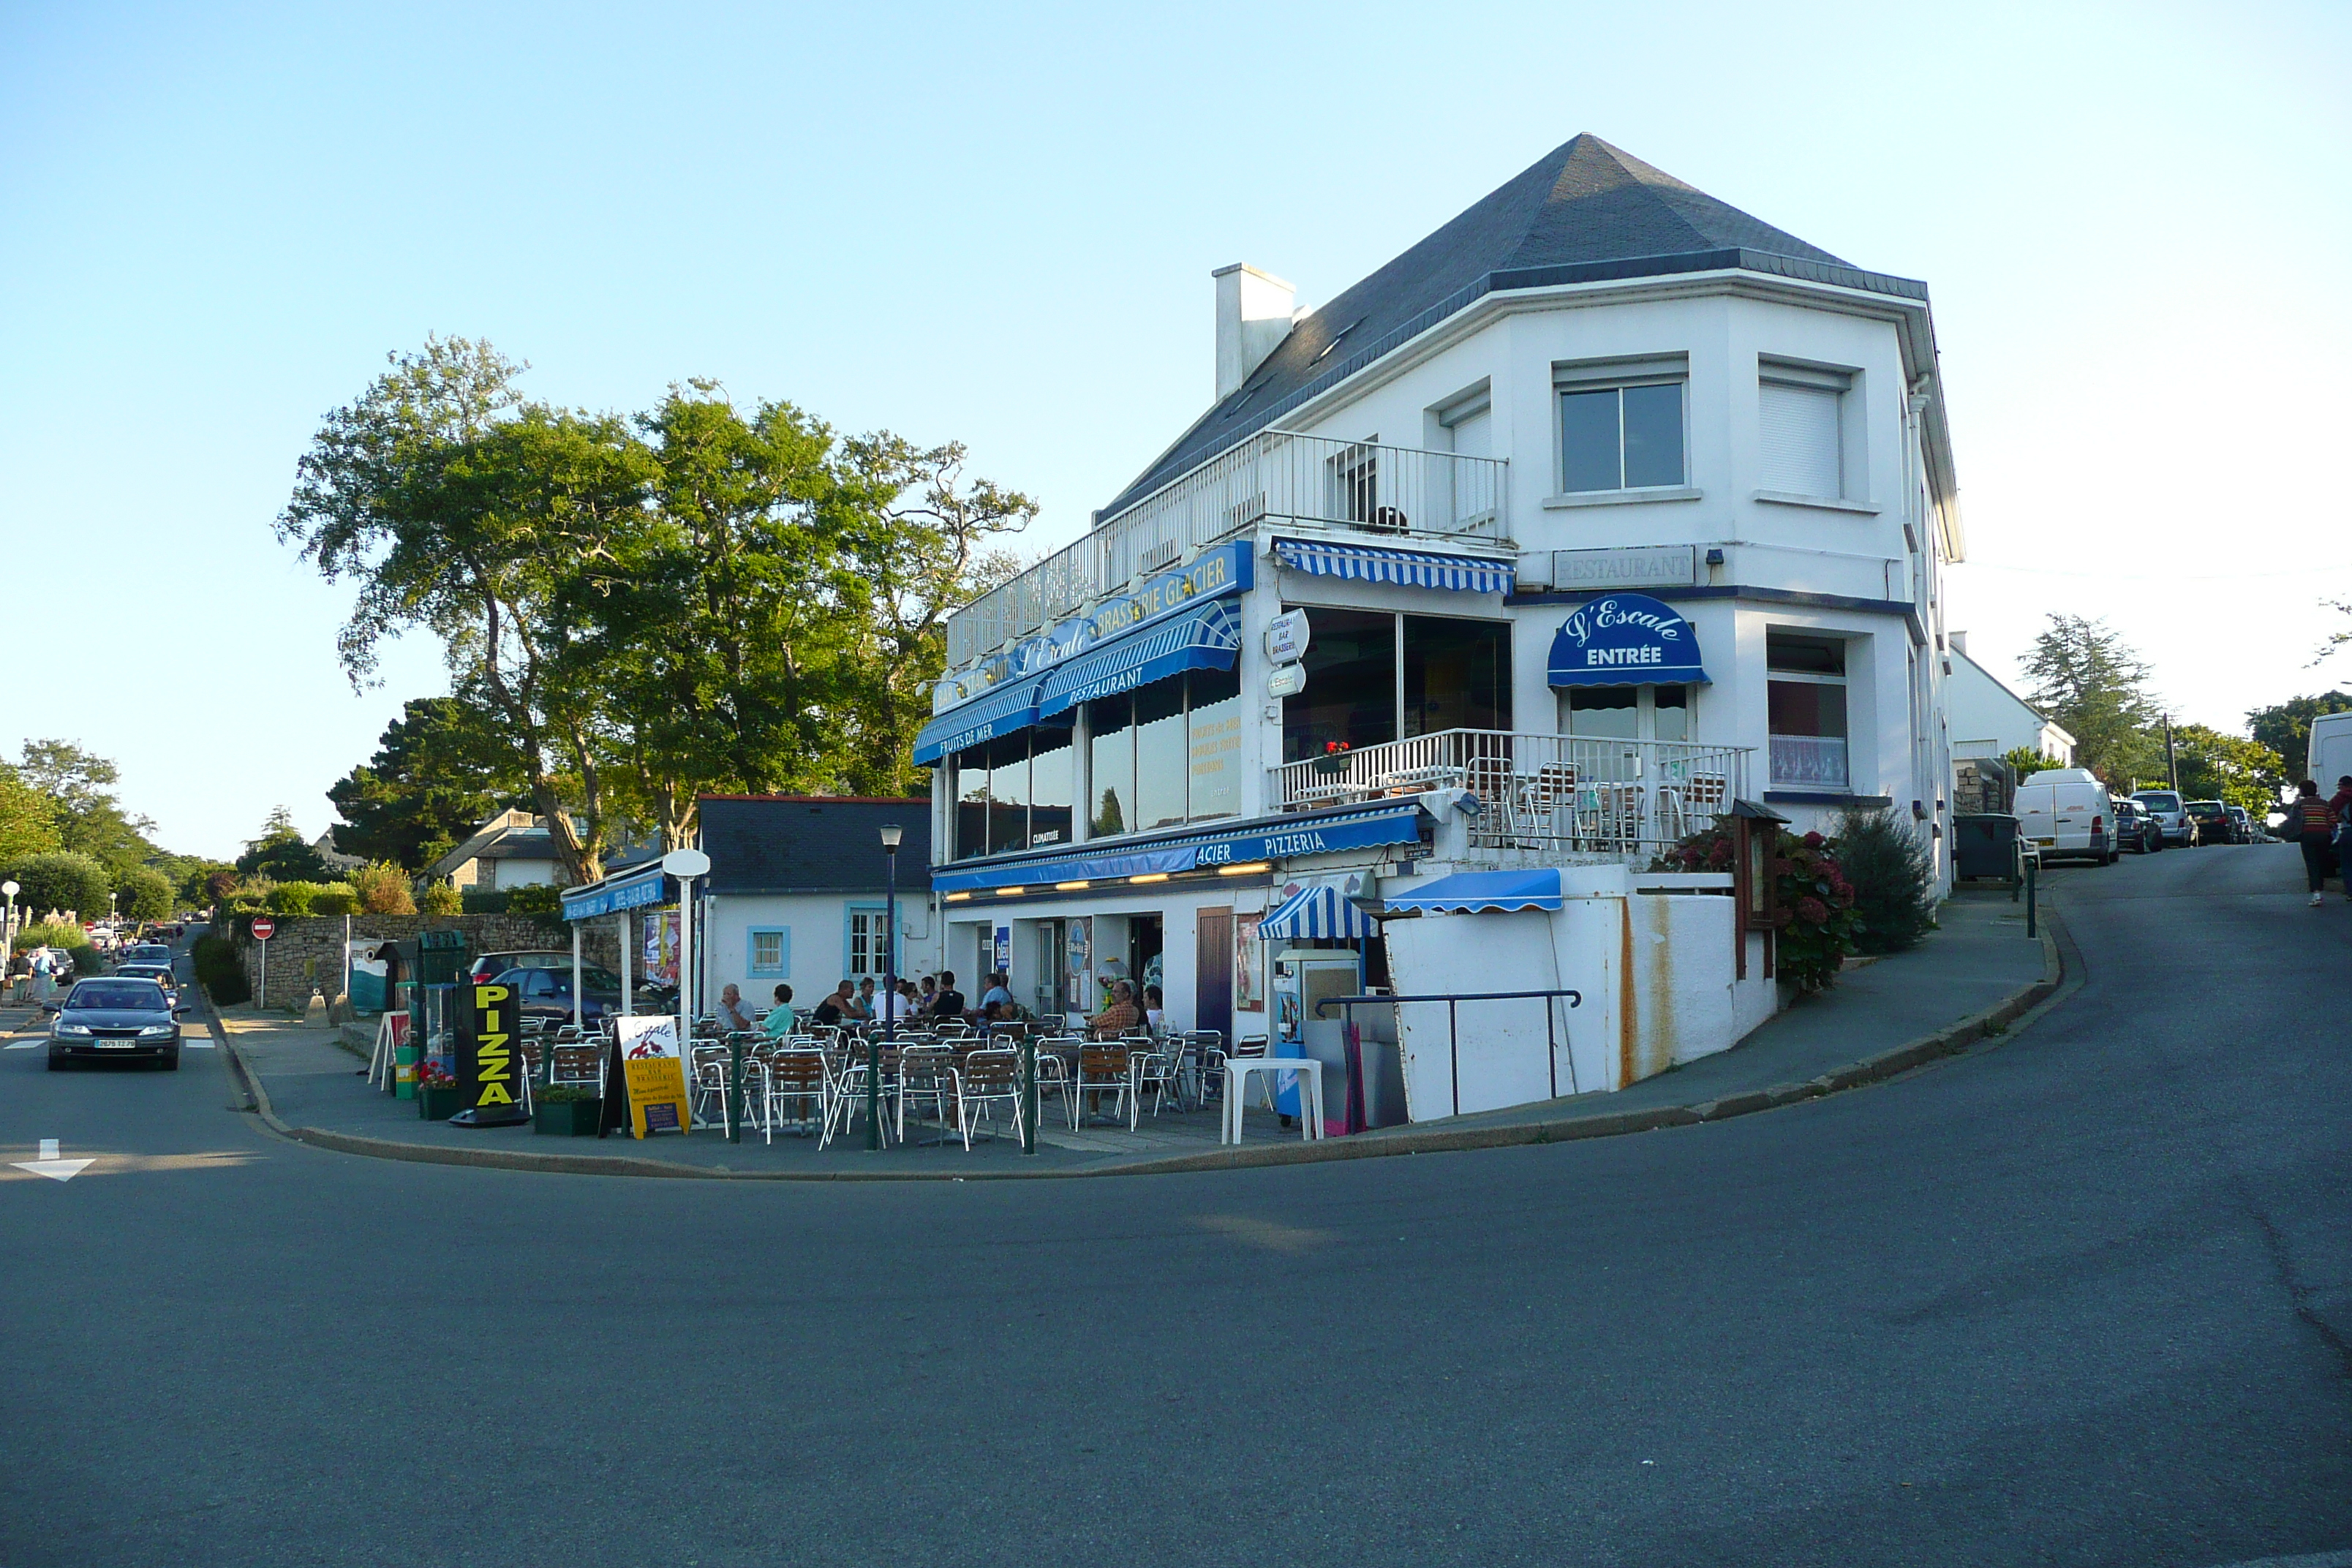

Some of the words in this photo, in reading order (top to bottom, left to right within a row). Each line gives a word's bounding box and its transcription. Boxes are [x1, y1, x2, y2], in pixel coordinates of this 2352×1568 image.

[1166, 557, 1225, 606] GLACIER
[1558, 556, 1689, 581] RESTAURANT
[1566, 600, 1683, 647] L'Escale
[1587, 644, 1661, 665] ENTRÉE
[938, 686, 952, 708] BAR
[957, 659, 1009, 700] ESTAUANT
[1068, 667, 1142, 705] RESTAURANT
[941, 736, 965, 754] FRUITS
[965, 731, 975, 745] DE
[976, 725, 993, 741] MER
[1197, 845, 1230, 863] ACIER
[1265, 832, 1326, 856] PIZZERIA
[476, 986, 513, 1106] PIZZA
